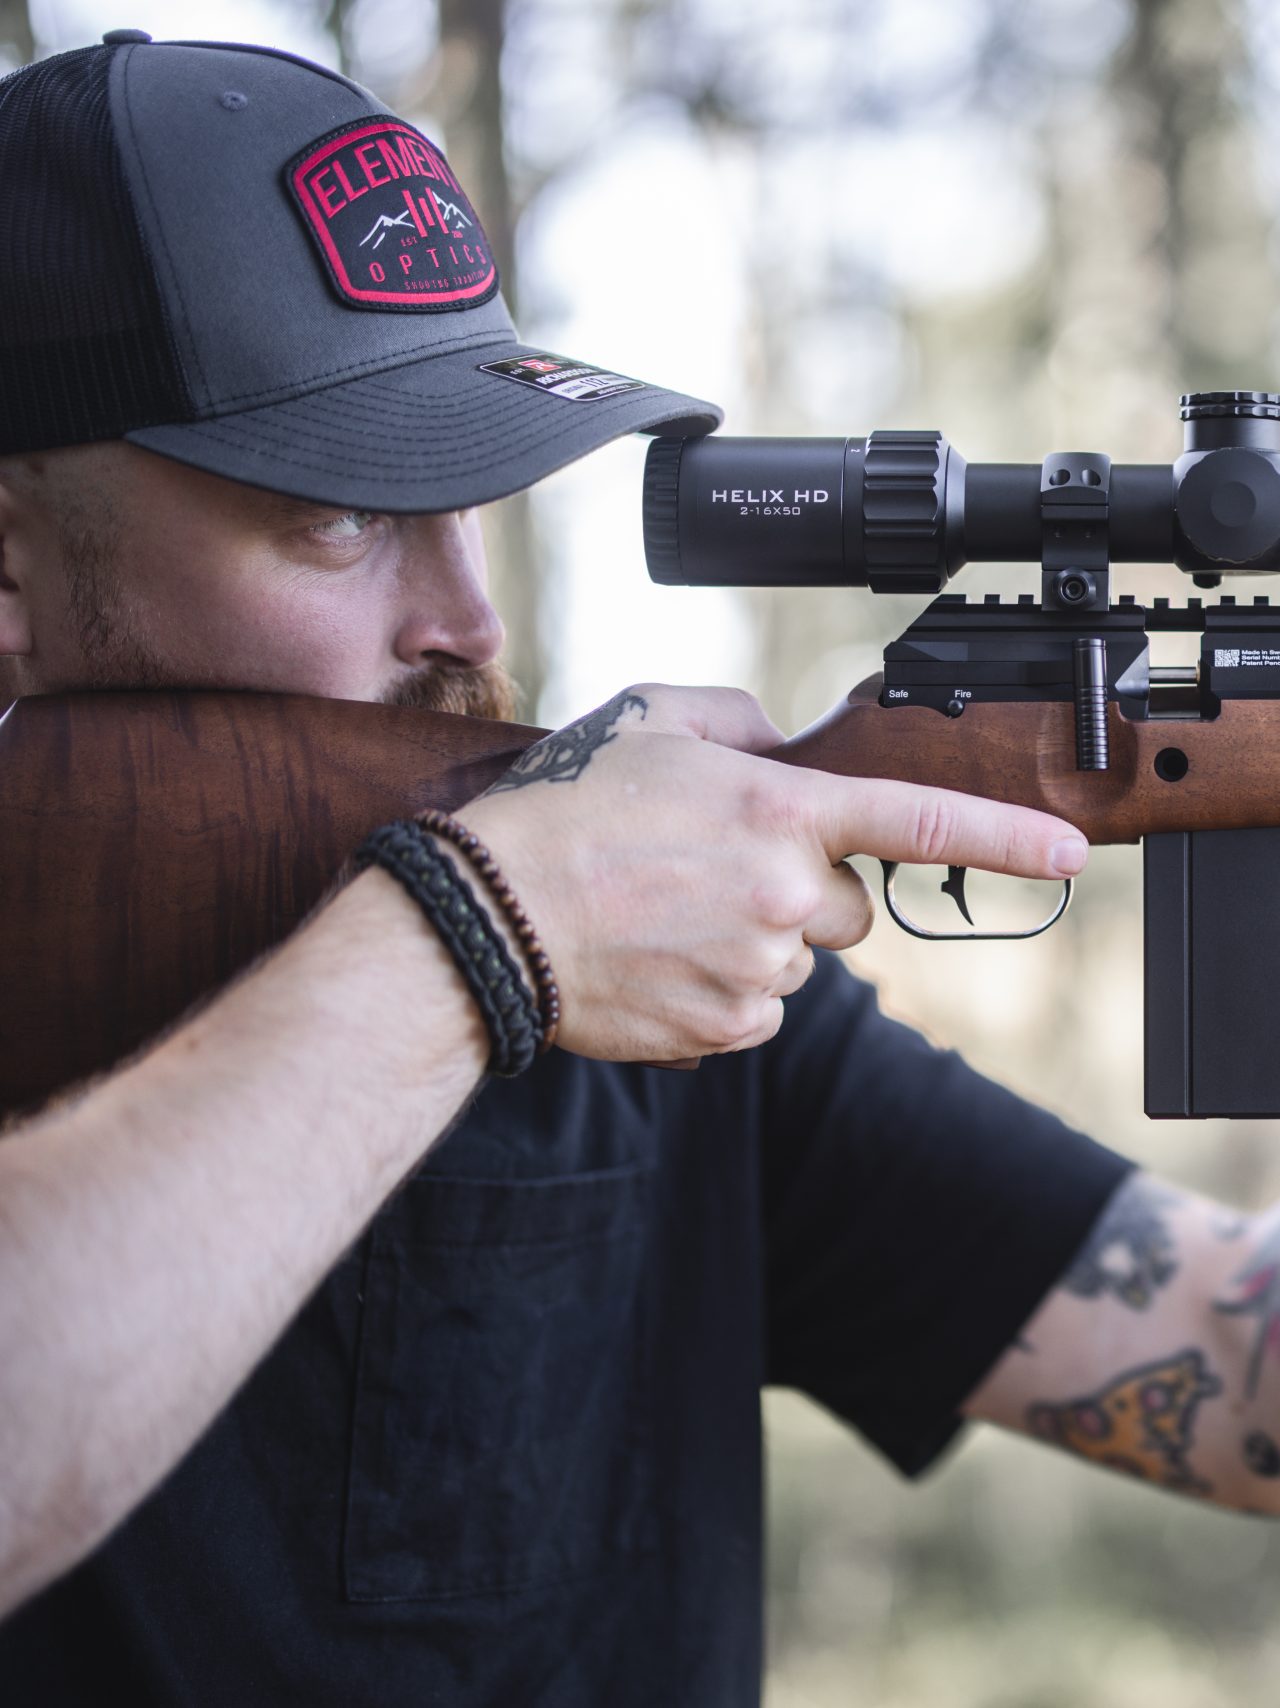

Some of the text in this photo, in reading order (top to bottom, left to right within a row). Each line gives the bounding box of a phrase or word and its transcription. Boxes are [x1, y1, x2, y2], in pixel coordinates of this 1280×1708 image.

[310, 135, 460, 219] ELEMENT
[368, 244, 487, 282] OPTICS
[712, 489, 829, 503] HELIX HD
[740, 506, 801, 516] 2-16X50
[888, 689, 972, 698] Safe Fire
